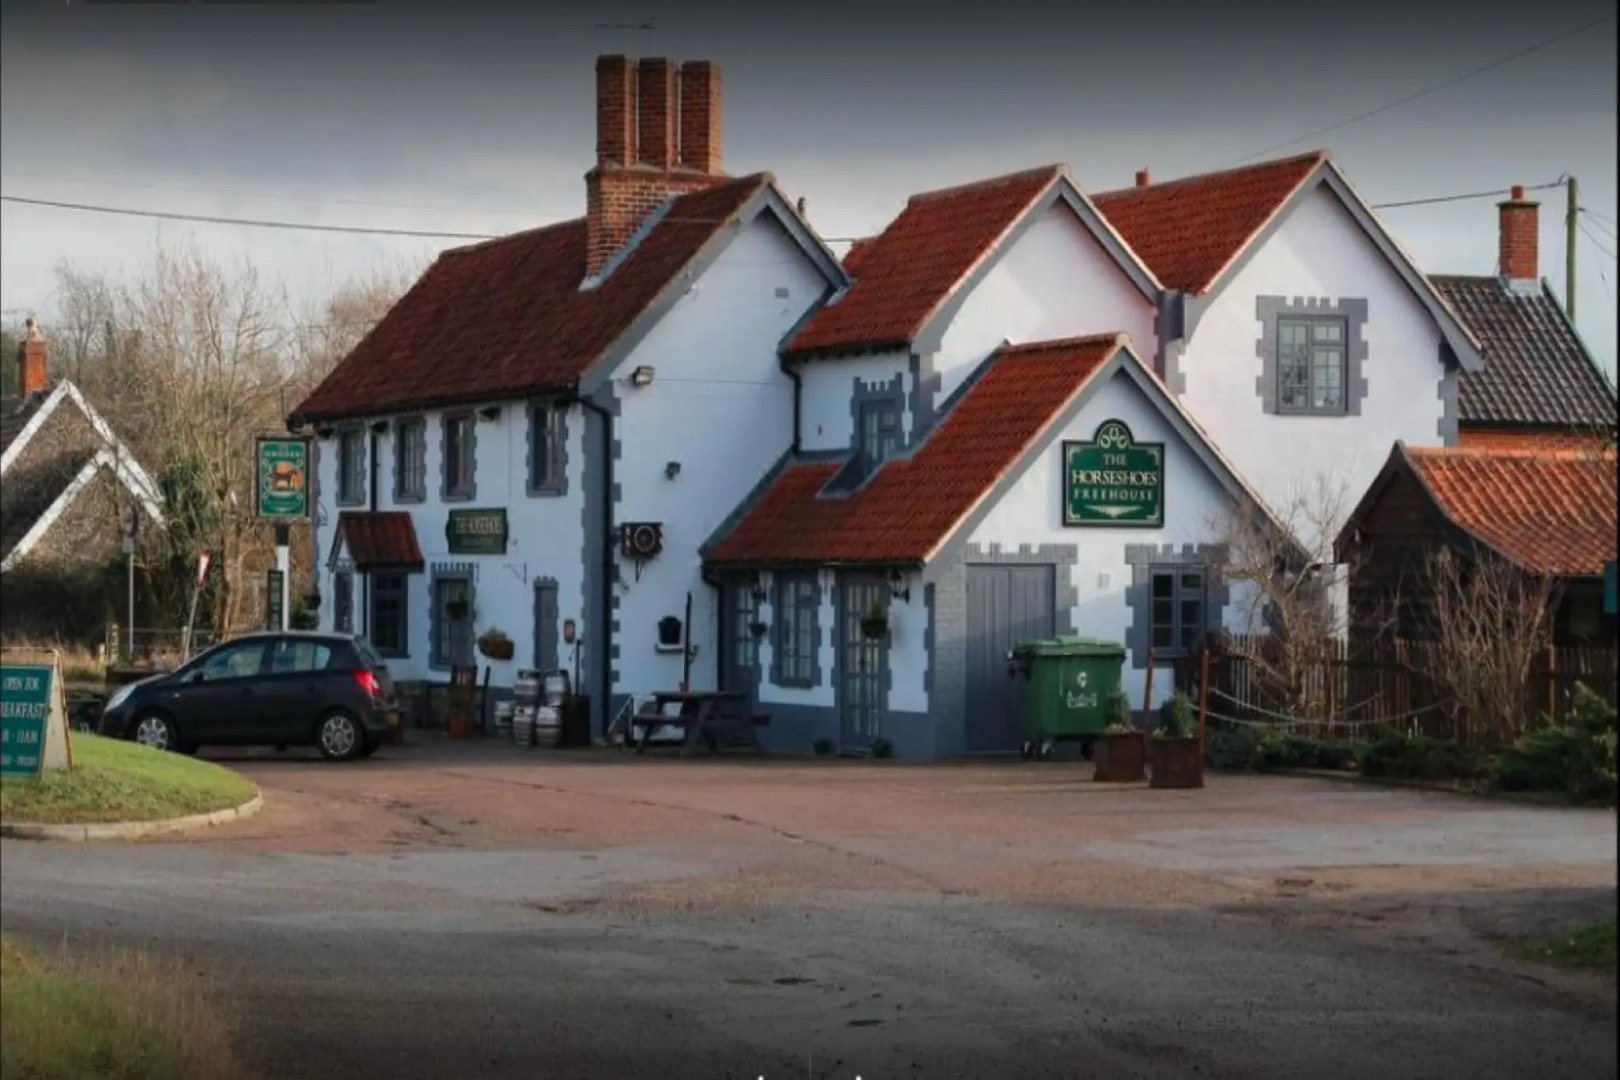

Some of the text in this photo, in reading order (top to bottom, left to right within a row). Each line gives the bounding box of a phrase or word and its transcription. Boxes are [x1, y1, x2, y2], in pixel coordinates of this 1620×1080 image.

[1103, 453, 1126, 466] THE
[1072, 469, 1157, 485] HORSESHOES
[1074, 488, 1153, 500] FREEHOUSE
[3, 676, 40, 690] OPEN FOR
